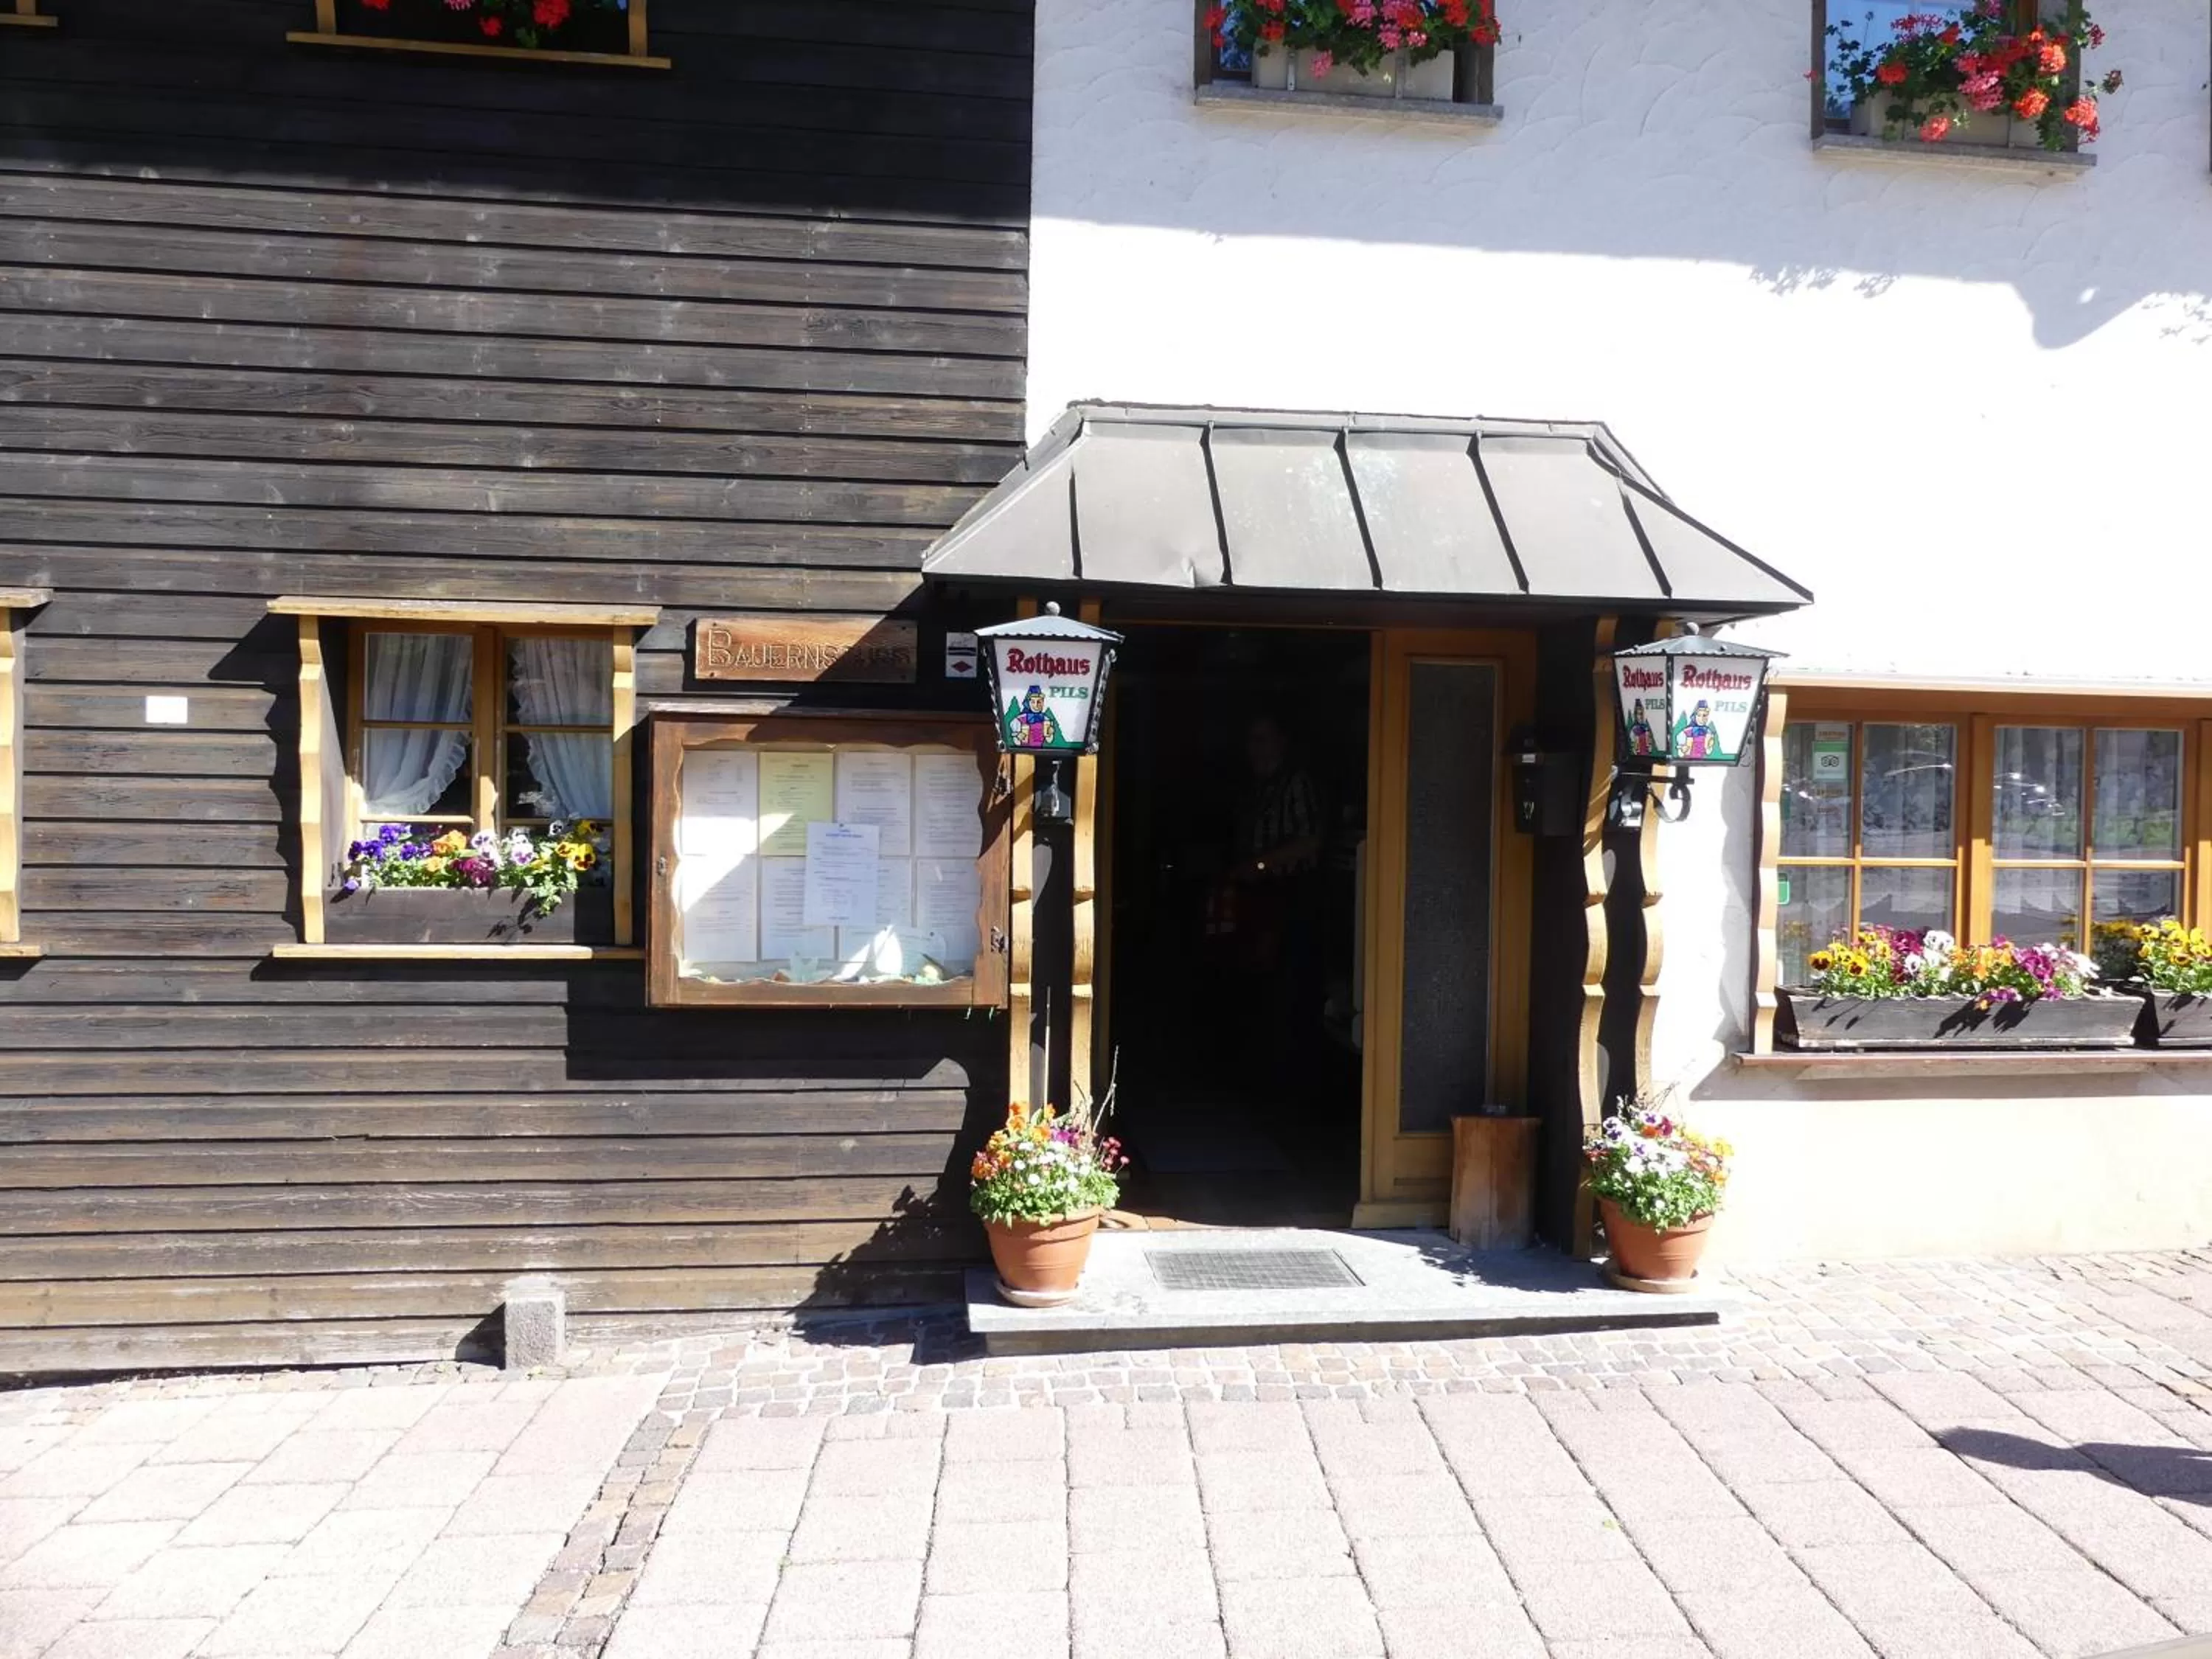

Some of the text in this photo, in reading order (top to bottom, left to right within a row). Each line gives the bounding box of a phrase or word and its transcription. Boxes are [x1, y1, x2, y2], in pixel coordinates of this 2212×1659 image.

[1005, 647, 1091, 678] Rothaus
[1622, 664, 1664, 692] Rothaus
[1680, 664, 1753, 693] Rothaus
[1048, 686, 1089, 699] PILS
[1645, 698, 1666, 710] PILS
[1714, 700, 1747, 713] PILS
